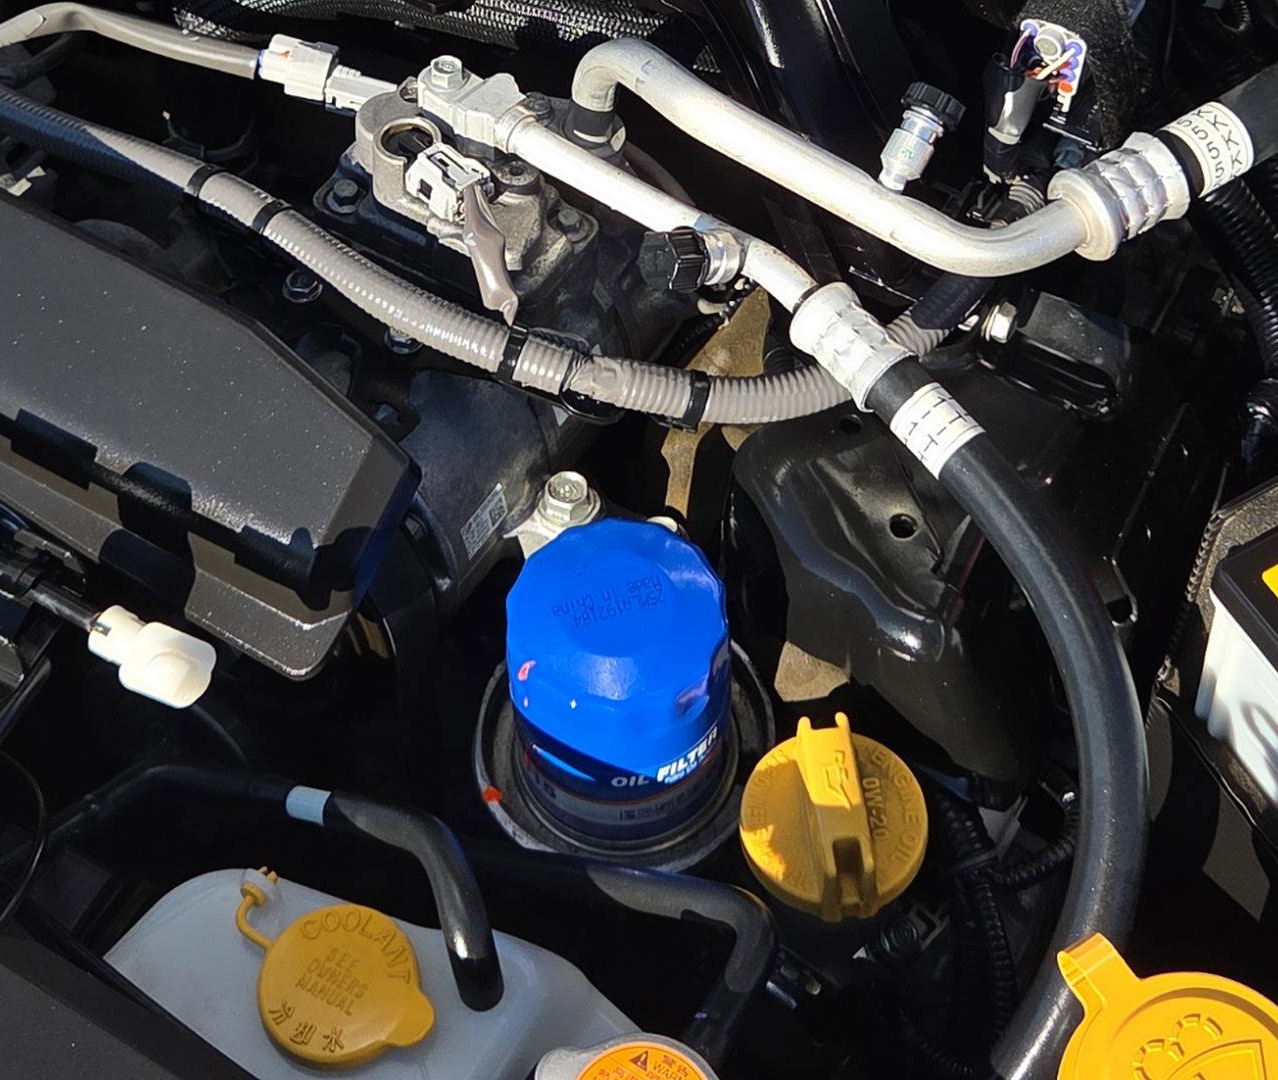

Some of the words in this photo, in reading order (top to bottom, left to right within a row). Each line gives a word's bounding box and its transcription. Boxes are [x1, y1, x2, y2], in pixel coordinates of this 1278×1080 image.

[600, 583, 620, 607] in
[626, 574, 663, 596] Made
[551, 592, 595, 619] China
[610, 774, 651, 788] OIL
[656, 726, 719, 782] FILTER
[871, 748, 921, 825] ENGINE
[861, 776, 890, 839] 0W-20
[890, 832, 920, 864] OIL
[299, 908, 412, 985] COOLANT
[325, 946, 361, 971] SEE
[294, 972, 356, 1017] MANUAL
